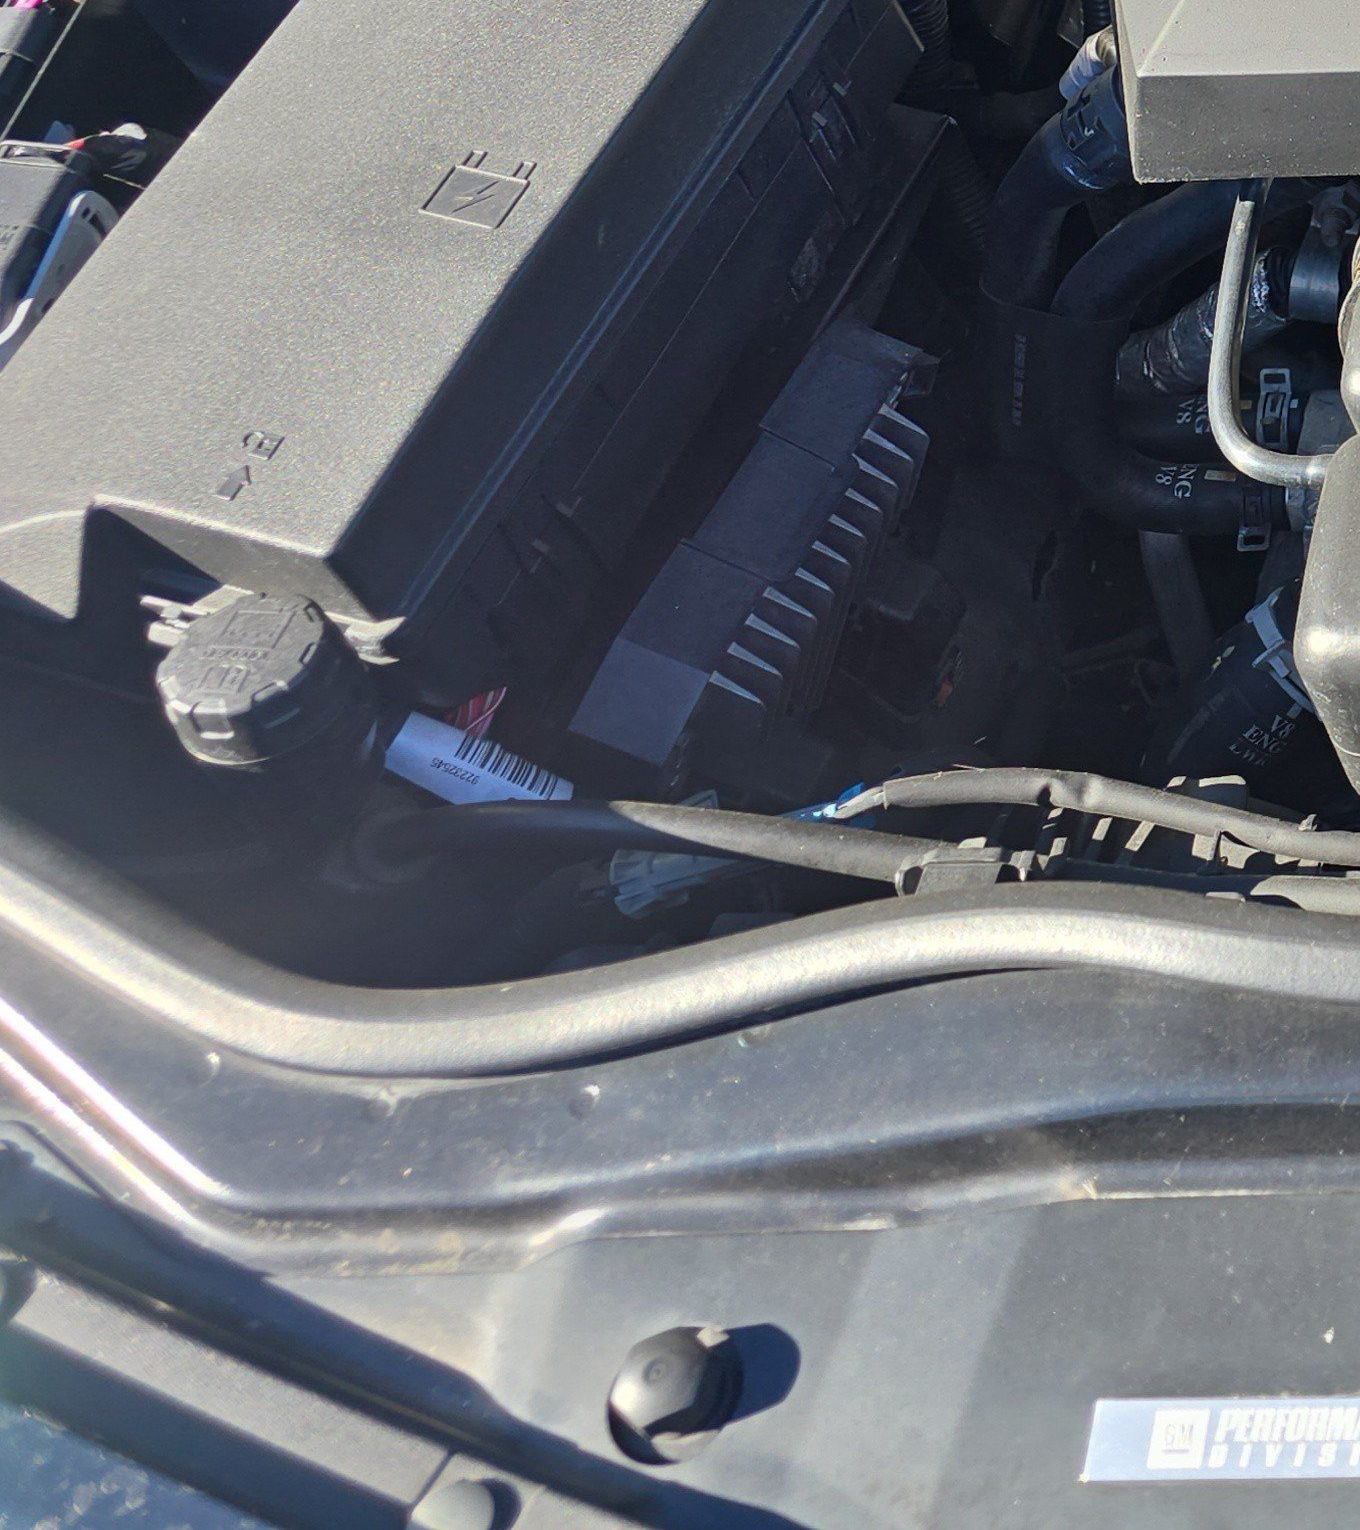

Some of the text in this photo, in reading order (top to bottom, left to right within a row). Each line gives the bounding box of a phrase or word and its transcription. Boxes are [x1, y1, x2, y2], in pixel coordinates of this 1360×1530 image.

[1155, 466, 1177, 485] V8
[1174, 463, 1200, 499] ENG
[1164, 1423, 1194, 1447] GM
